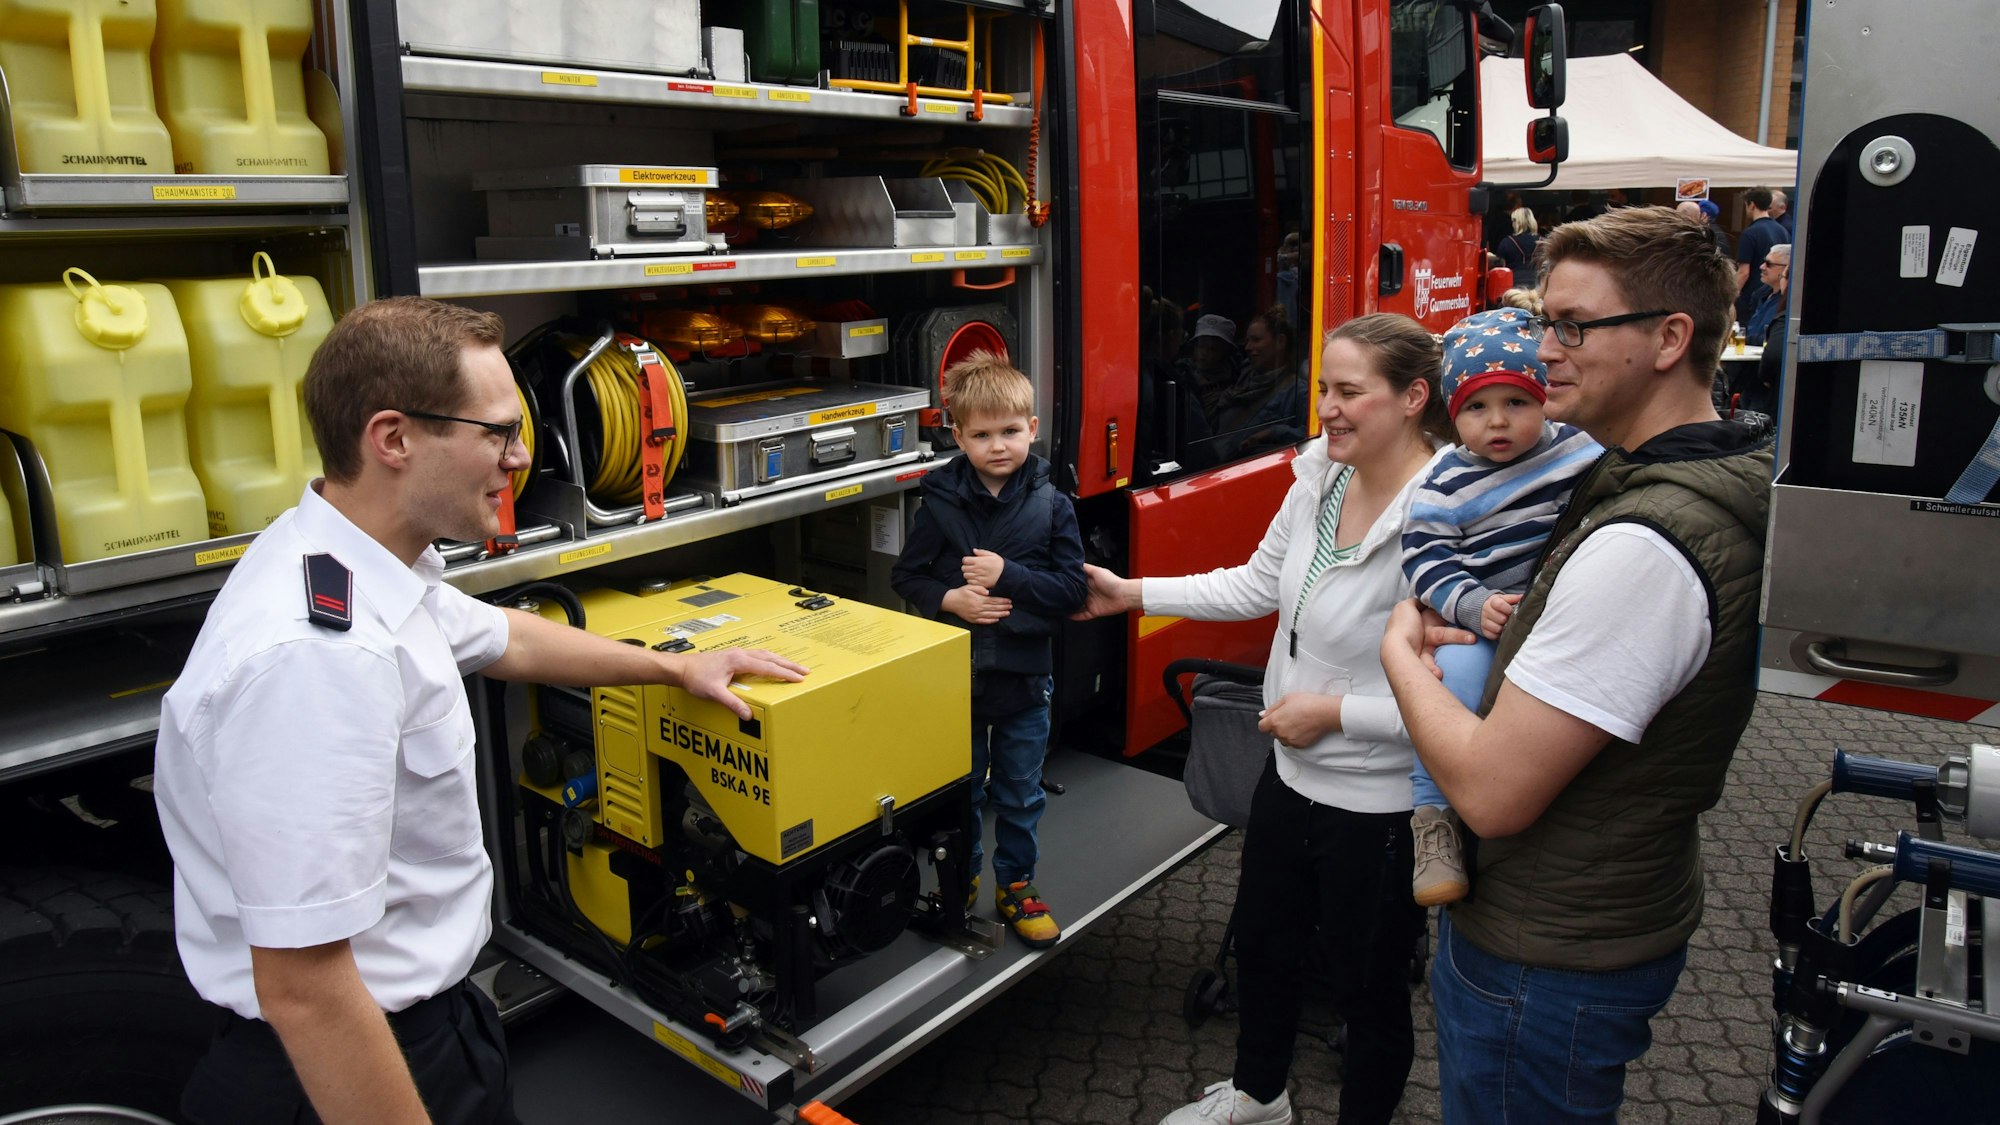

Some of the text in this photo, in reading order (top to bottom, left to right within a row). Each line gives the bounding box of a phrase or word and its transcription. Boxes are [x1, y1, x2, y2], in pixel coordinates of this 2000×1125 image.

[61, 154, 148, 166] SCHAUMMITTEL
[236, 158, 309, 167] SCHAUMMITTEL
[633, 170, 696, 183] Elektrowerkzeug
[155, 187, 234, 197] SCHAUMKANISTER 20L
[1958, 243, 1972, 274] Eigentum
[1430, 272, 1463, 290] Feuerwehr
[1429, 292, 1470, 313] Gummersbach
[821, 407, 865, 421] Handwerkzeug
[1868, 399, 1878, 426] 240kN
[1898, 401, 1908, 429] 135kN
[1909, 403, 1917, 427] Nennlast
[1915, 501, 2000, 517] 1 Schwelleraufsat
[104, 529, 181, 551] SCHAUMMITTEL
[660, 716, 769, 782] EISEMANN
[711, 767, 770, 806] BSKA 9E
